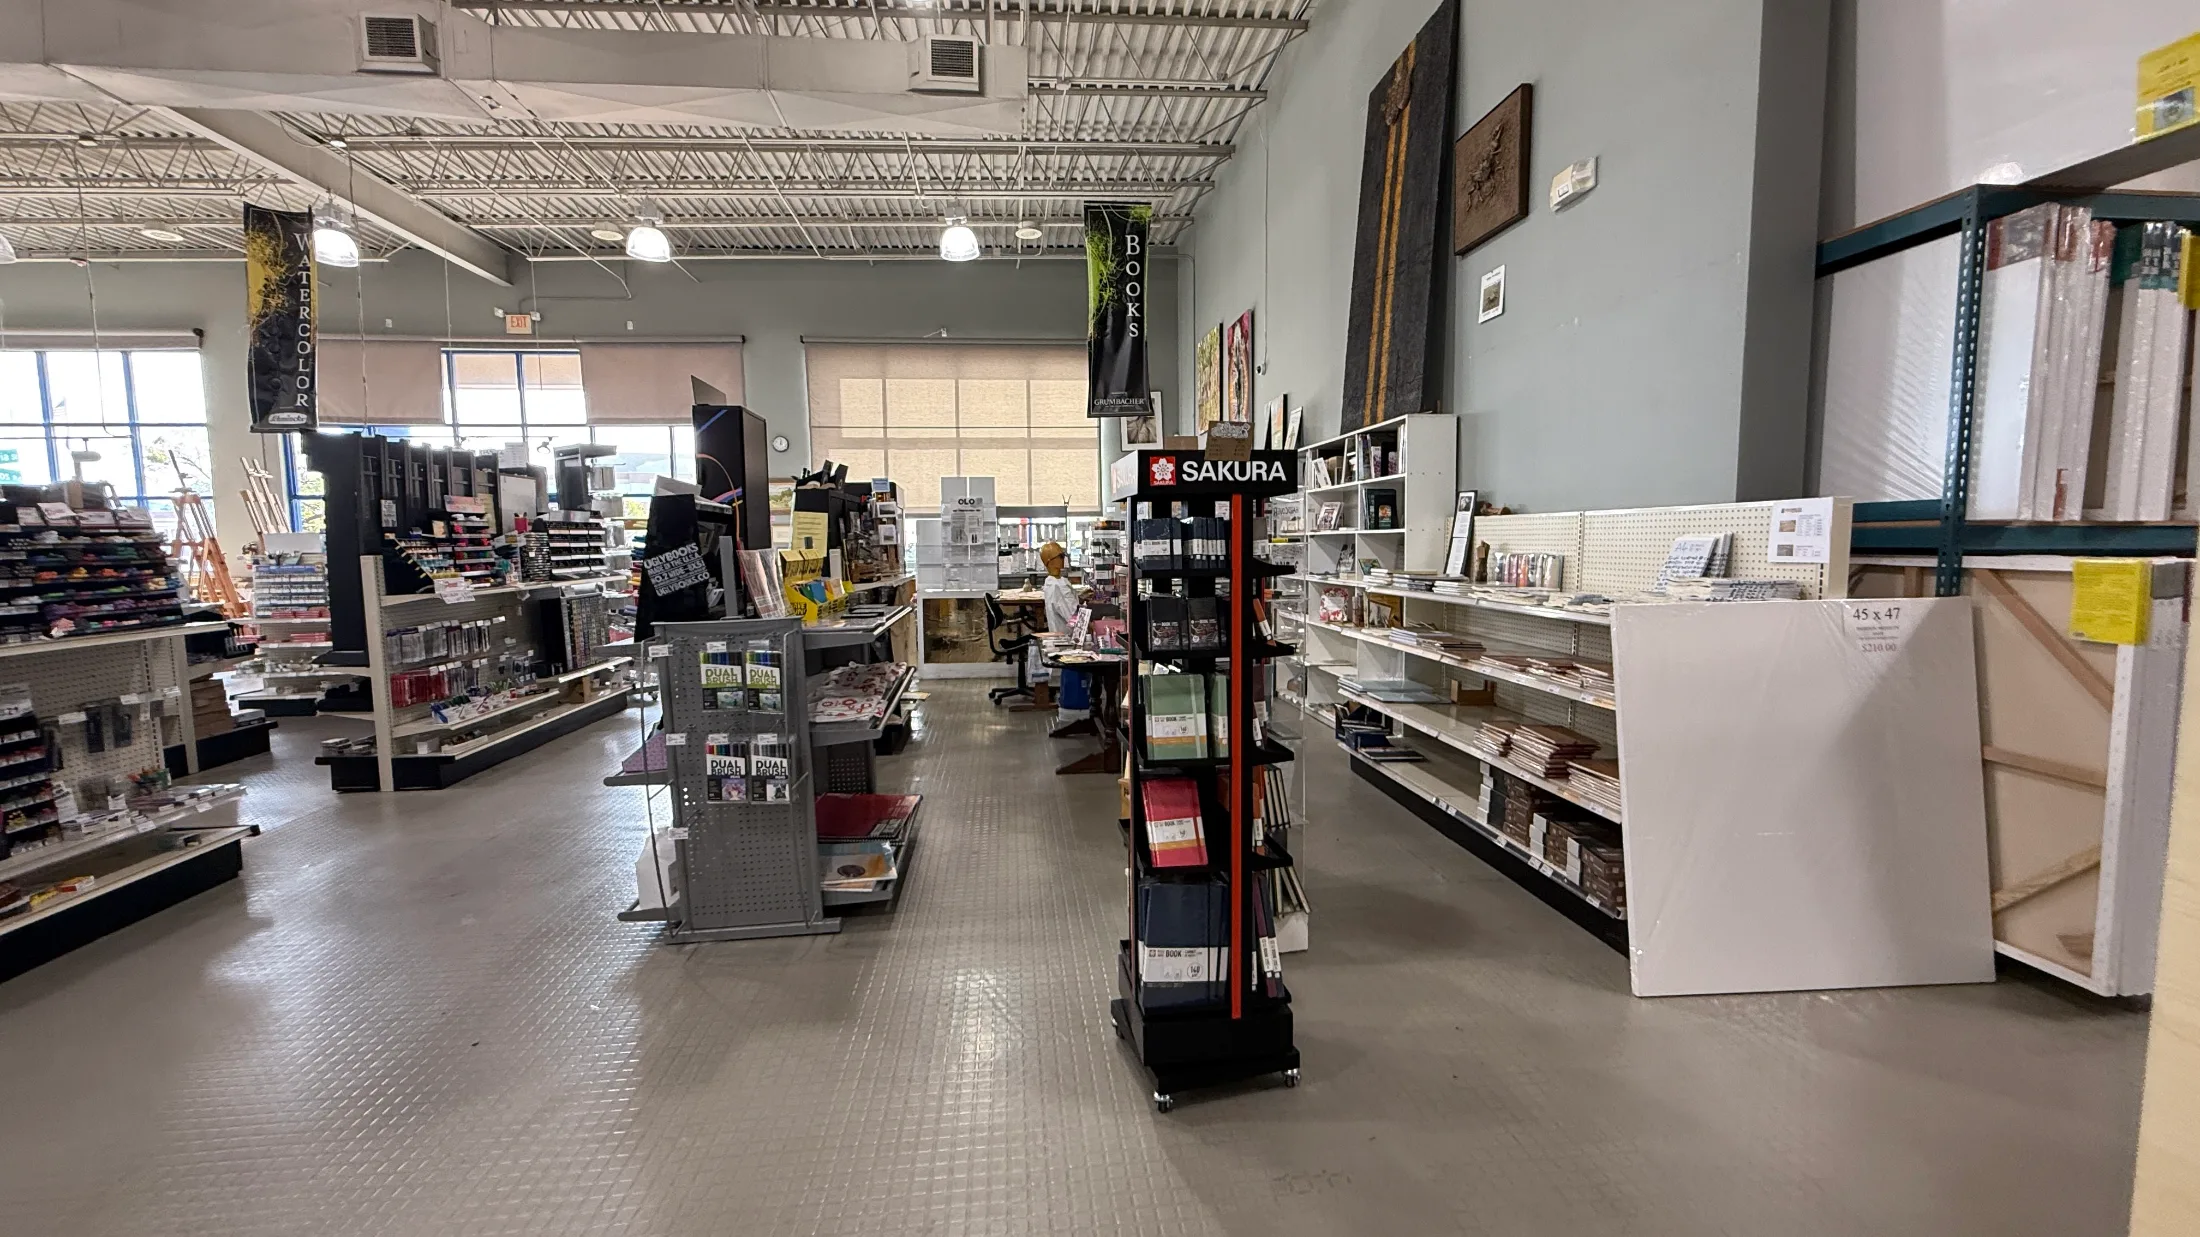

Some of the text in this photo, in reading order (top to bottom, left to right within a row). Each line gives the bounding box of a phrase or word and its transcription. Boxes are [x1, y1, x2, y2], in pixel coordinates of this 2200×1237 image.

[1125, 235, 1141, 338] BOOKS
[294, 233, 312, 407] WATERCOLOR
[511, 316, 527, 327] EXIT
[1094, 398, 1145, 406] GRUMBACHER
[1182, 461, 1287, 482] SAKURA
[644, 542, 699, 569] UGLYBOOKS
[1853, 607, 1901, 621] 45 x 47
[705, 667, 738, 678] DUAL
[749, 669, 777, 679] DUAL
[706, 675, 738, 685] BRUSH
[750, 677, 777, 687] BRUSH
[710, 759, 742, 769] DUAL
[755, 760, 787, 770] DUAL
[711, 767, 741, 777] BRUSH
[756, 767, 787, 777] BRUSH
[1166, 949, 1182, 957] BOOK
